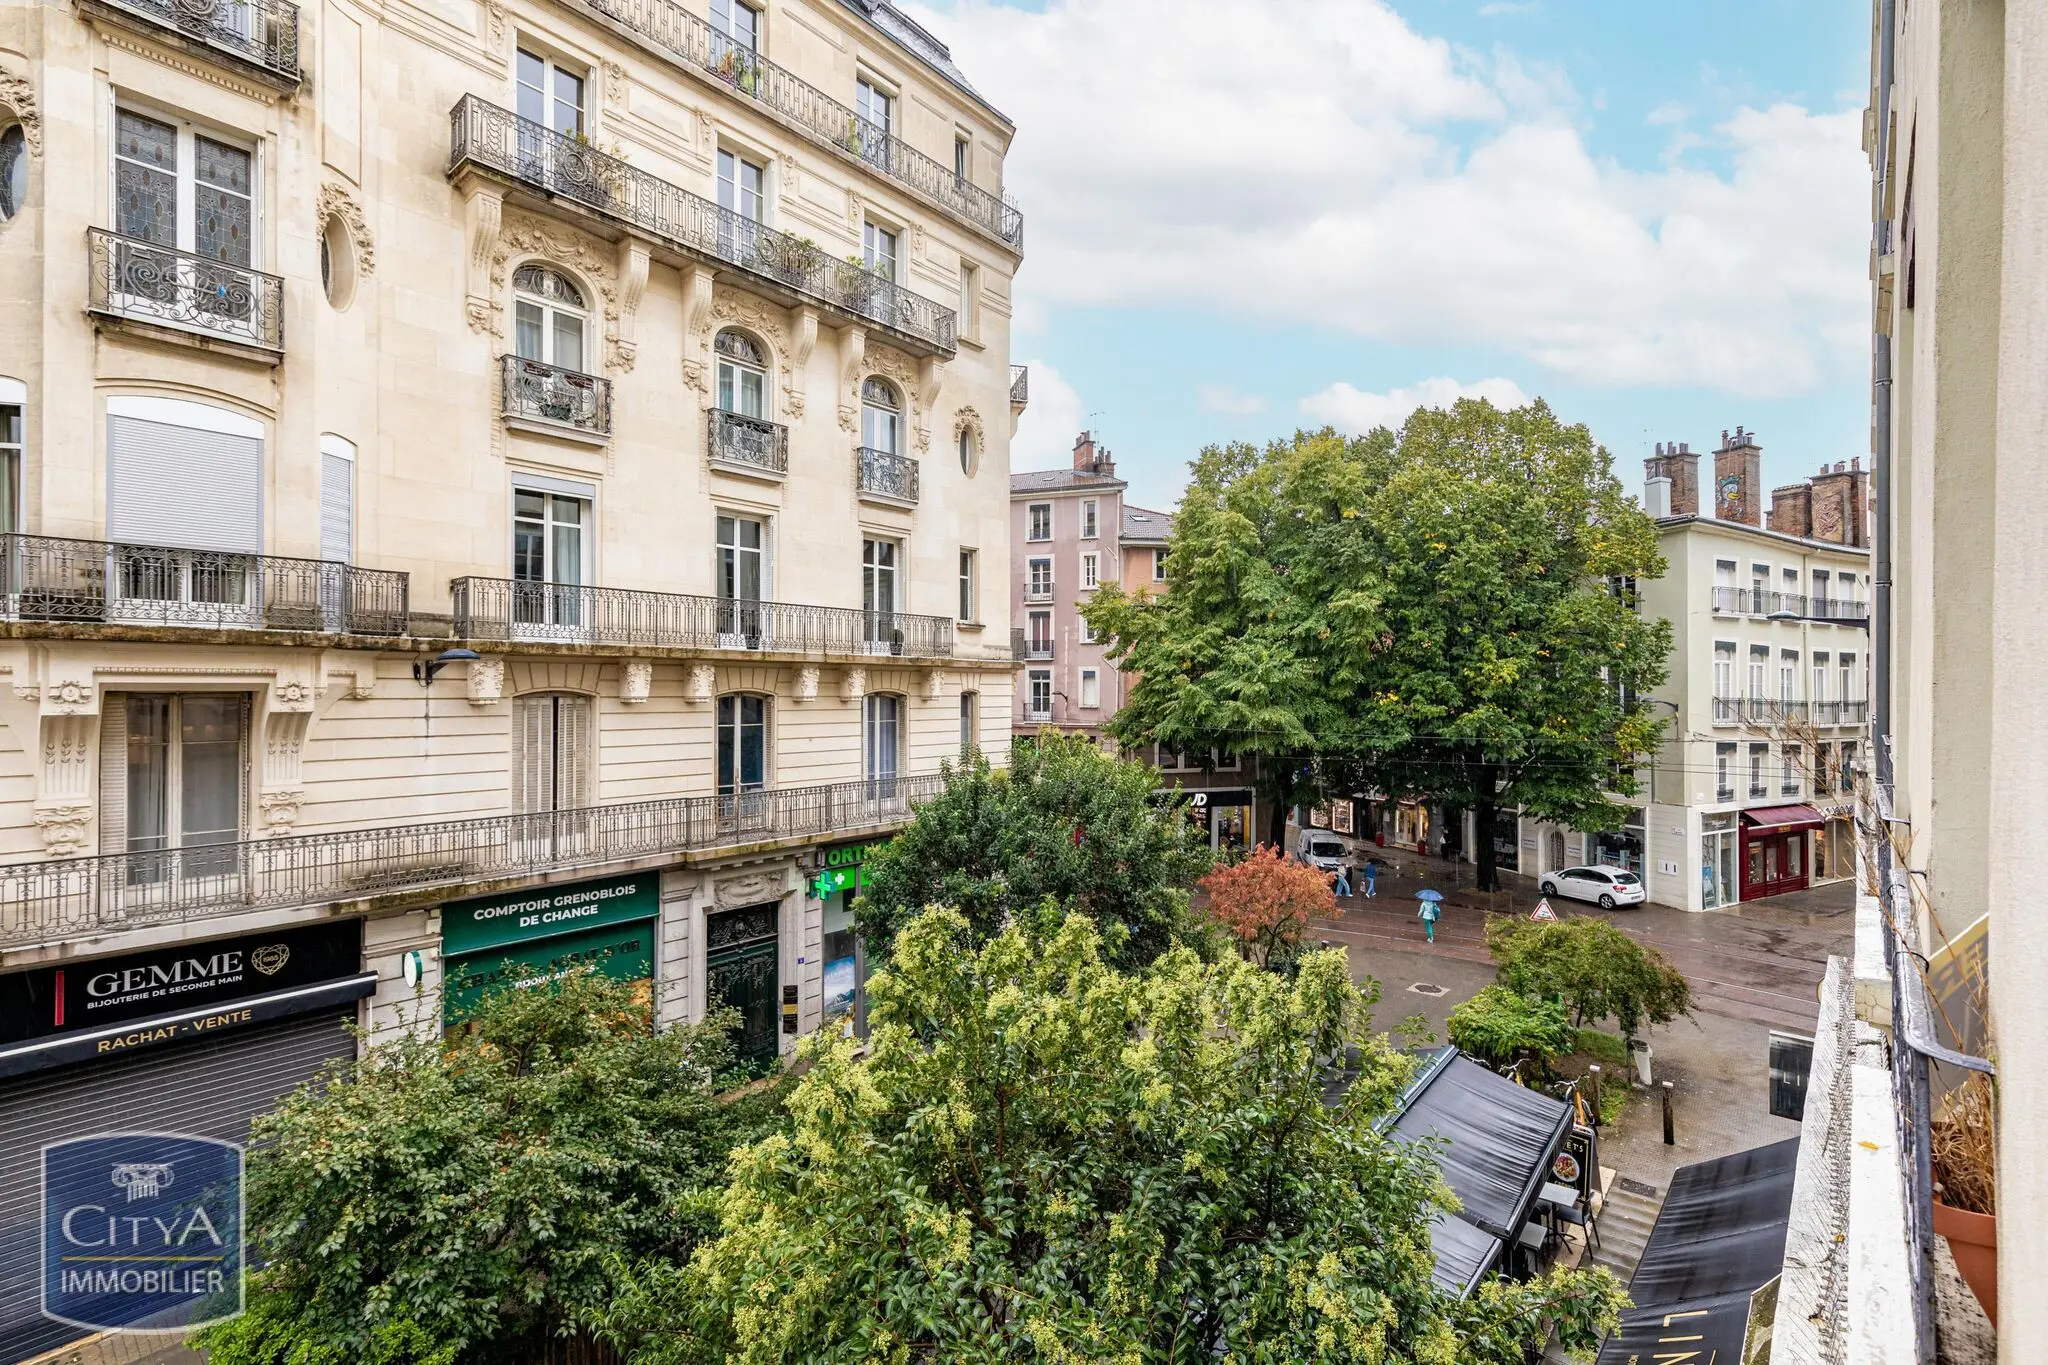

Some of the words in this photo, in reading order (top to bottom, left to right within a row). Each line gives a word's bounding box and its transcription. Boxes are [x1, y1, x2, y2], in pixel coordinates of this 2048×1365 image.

[1190, 793, 1207, 807] JD
[828, 845, 864, 866] ORT
[473, 899, 551, 921] COMPTOIR
[554, 884, 636, 907] GRENOBLOIS
[519, 915, 539, 928] DE
[542, 904, 599, 924] CHANGE
[86, 951, 243, 997] GEMME
[87, 992, 150, 1010] BIJOUTERIE
[152, 989, 167, 998] DE
[168, 979, 216, 994] SECONDE
[218, 974, 243, 985] MAIN
[98, 1025, 178, 1053] RACHAT
[192, 1009, 252, 1031] VENTE
